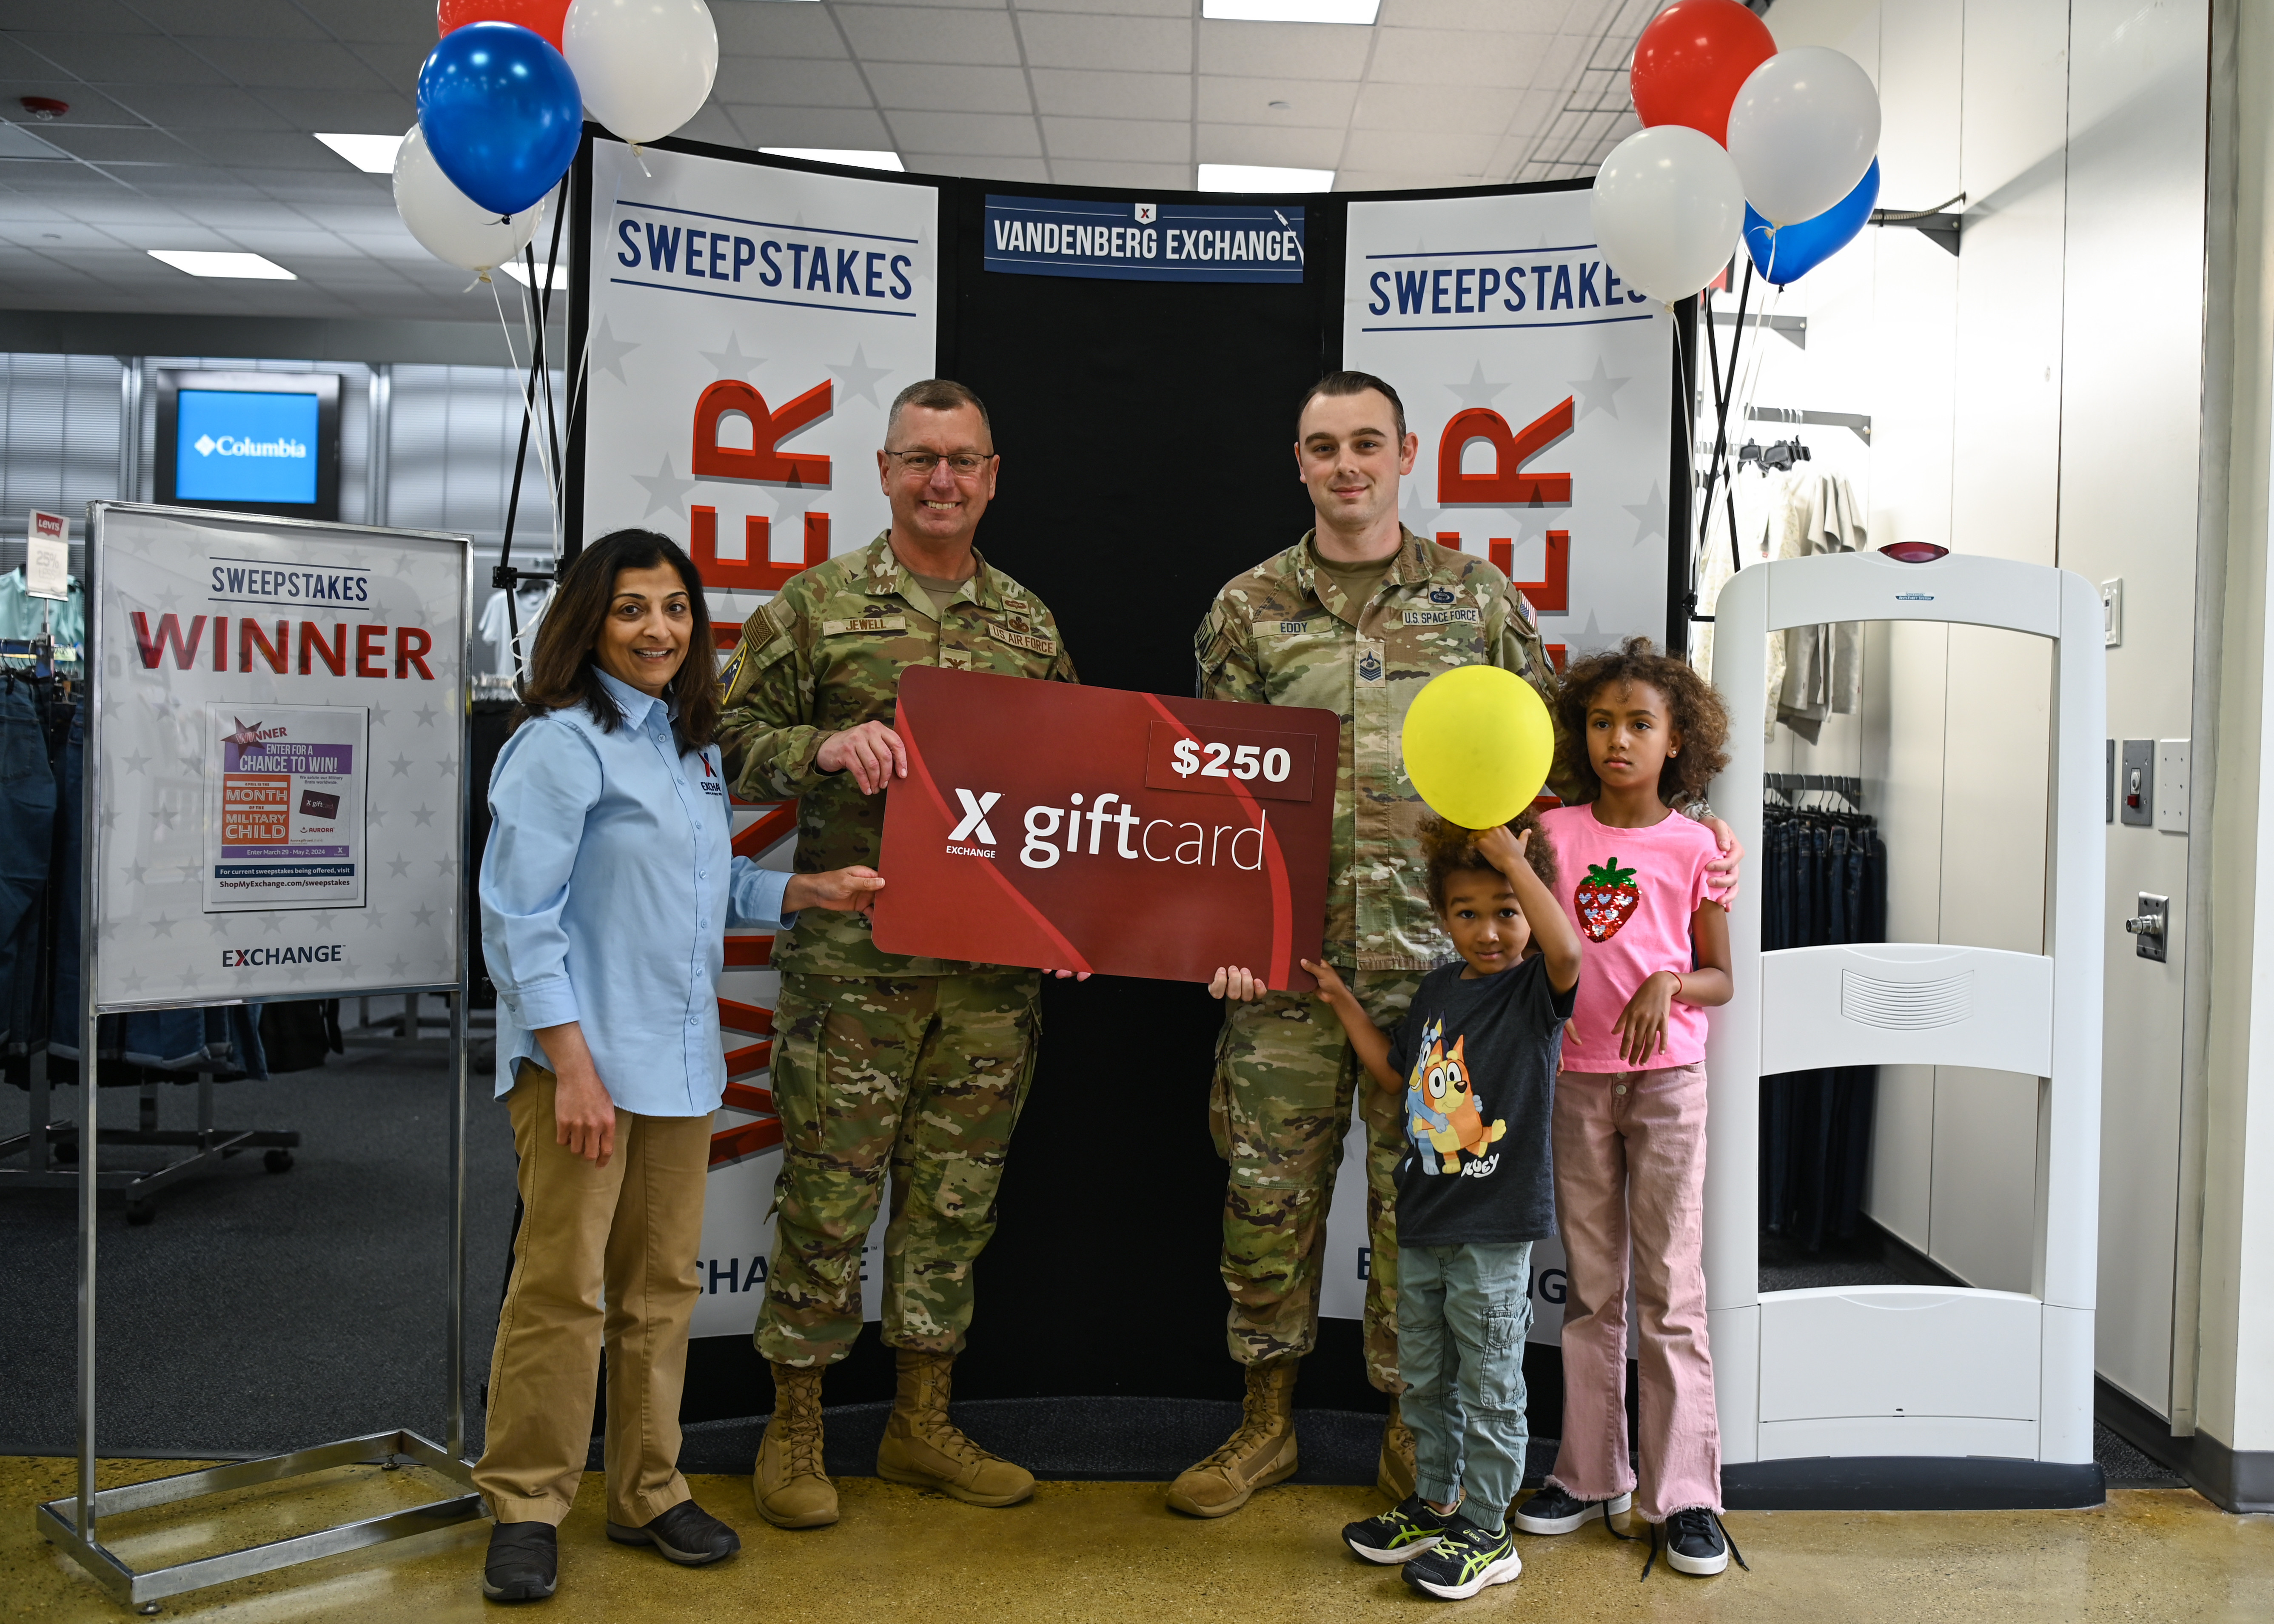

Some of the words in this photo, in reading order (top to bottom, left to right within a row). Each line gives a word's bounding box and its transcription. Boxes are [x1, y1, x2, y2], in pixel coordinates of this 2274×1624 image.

[994, 220, 1157, 259] VANDENBERG
[1166, 230, 1296, 261] EXCHANGE
[618, 219, 912, 300] SWEEPSTAKES
[216, 435, 306, 458] Columbia
[36, 551, 59, 568] 25%
[212, 566, 368, 601] SWEEPSTAKES
[845, 619, 886, 630] JEWELL
[1405, 613, 1419, 624] U.S.
[1422, 612, 1448, 623] SPACE
[1450, 610, 1476, 622] FORCE
[1280, 622, 1308, 633] EDDY
[131, 611, 435, 680] WINNER
[1009, 634, 1023, 645] AIR
[1025, 637, 1053, 653] FORCE
[235, 727, 288, 744] WINNER
[266, 744, 290, 754] ENTER
[292, 745, 306, 755] FOR
[308, 745, 313, 755] A
[240, 755, 288, 772] CHANCE
[290, 756, 305, 772] TO
[309, 757, 337, 772] WIN!
[1171, 737, 1291, 783] $250
[226, 789, 287, 801] MONTH
[226, 814, 287, 823] MILITARY
[226, 825, 285, 838] CHILD
[1020, 792, 1266, 871] giftcard
[946, 845, 996, 858] EXCHANGE
[220, 880, 350, 889] ShopMyExchange.com/sweepstakes
[222, 945, 342, 967] EXCHANGE
[1469, 1532, 1481, 1542] asics
